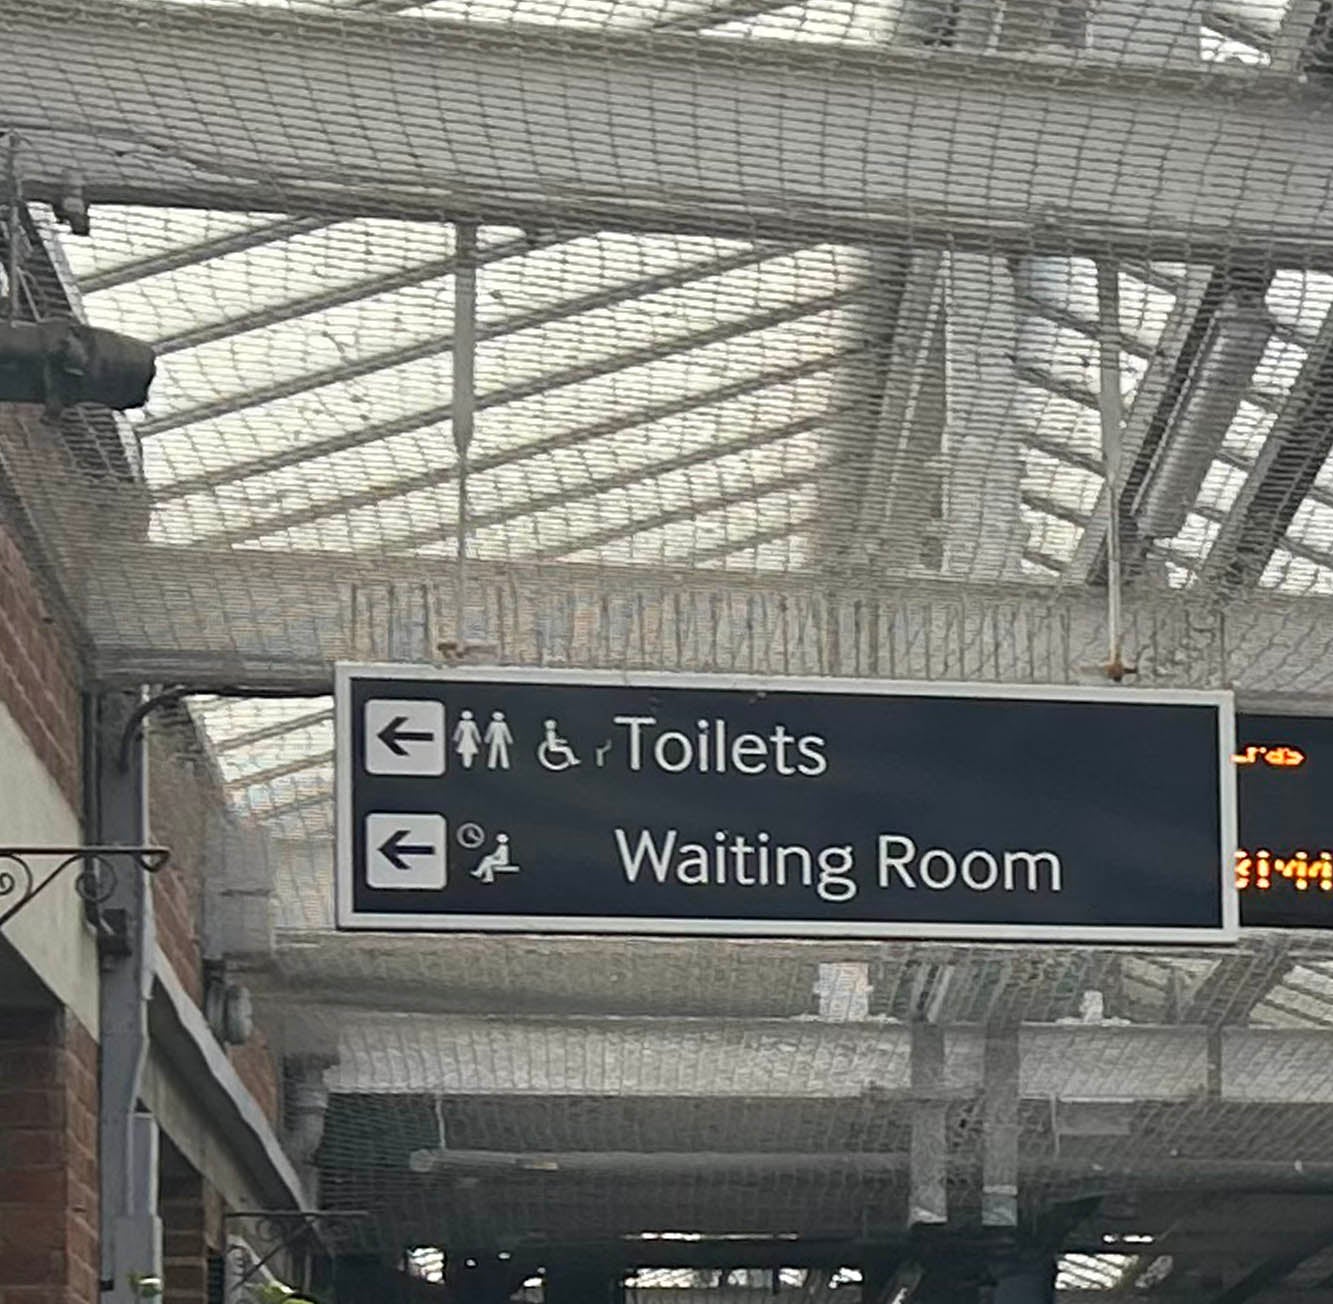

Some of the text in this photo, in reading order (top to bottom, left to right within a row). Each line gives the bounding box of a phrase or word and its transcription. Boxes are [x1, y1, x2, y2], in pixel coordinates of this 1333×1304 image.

[613, 715, 828, 776] Toilets
[614, 828, 1062, 901] Waiting Room
